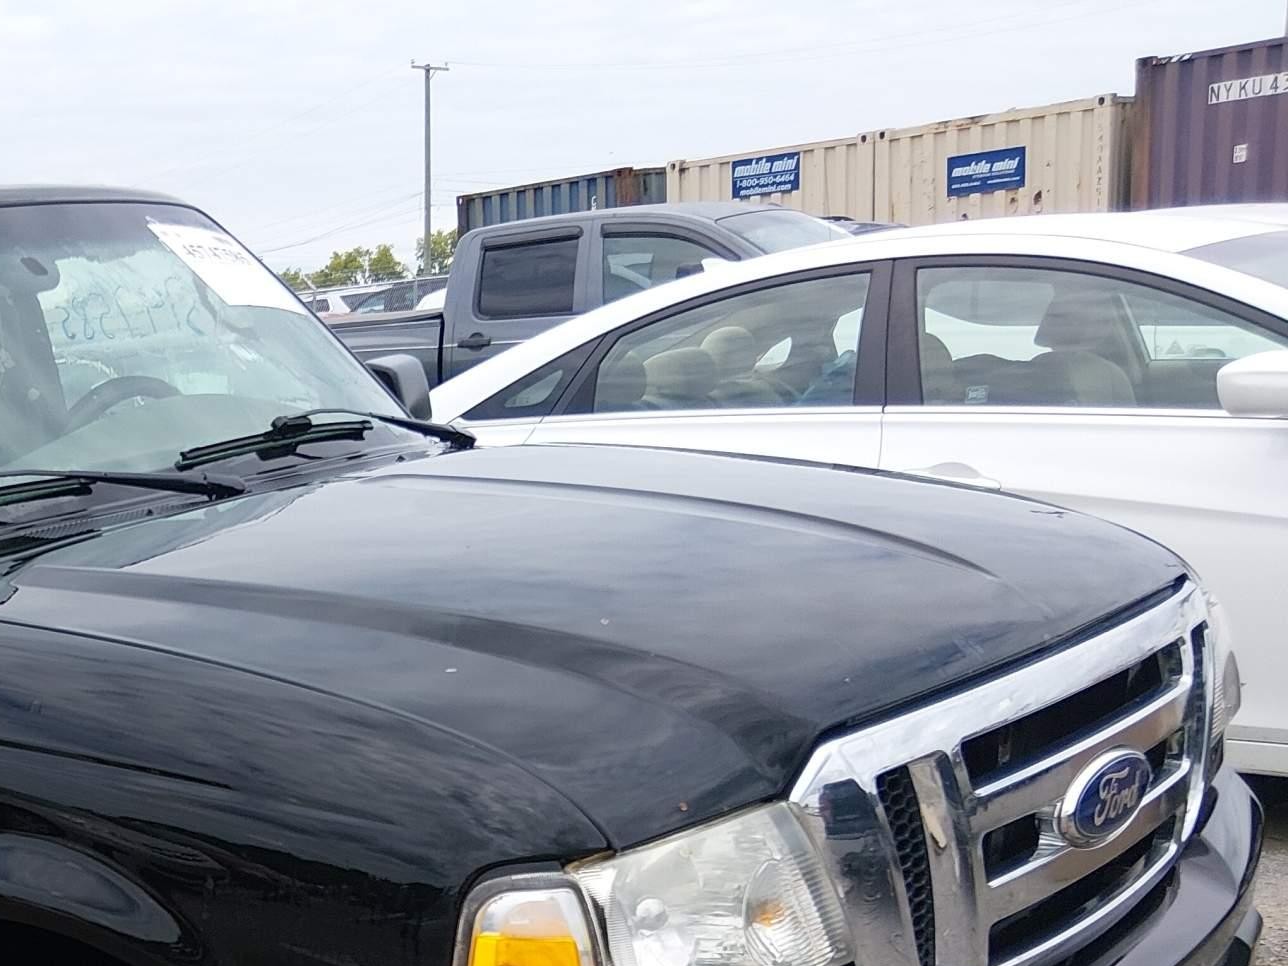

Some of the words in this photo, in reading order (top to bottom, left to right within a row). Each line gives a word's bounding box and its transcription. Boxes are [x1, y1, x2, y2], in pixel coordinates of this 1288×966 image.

[734, 158, 771, 177] mobile
[772, 155, 799, 172] mini
[951, 160, 991, 177] mobile
[992, 157, 1020, 172] mini
[739, 184, 792, 196] mobilemini.com
[1094, 767, 1143, 827] Ford
